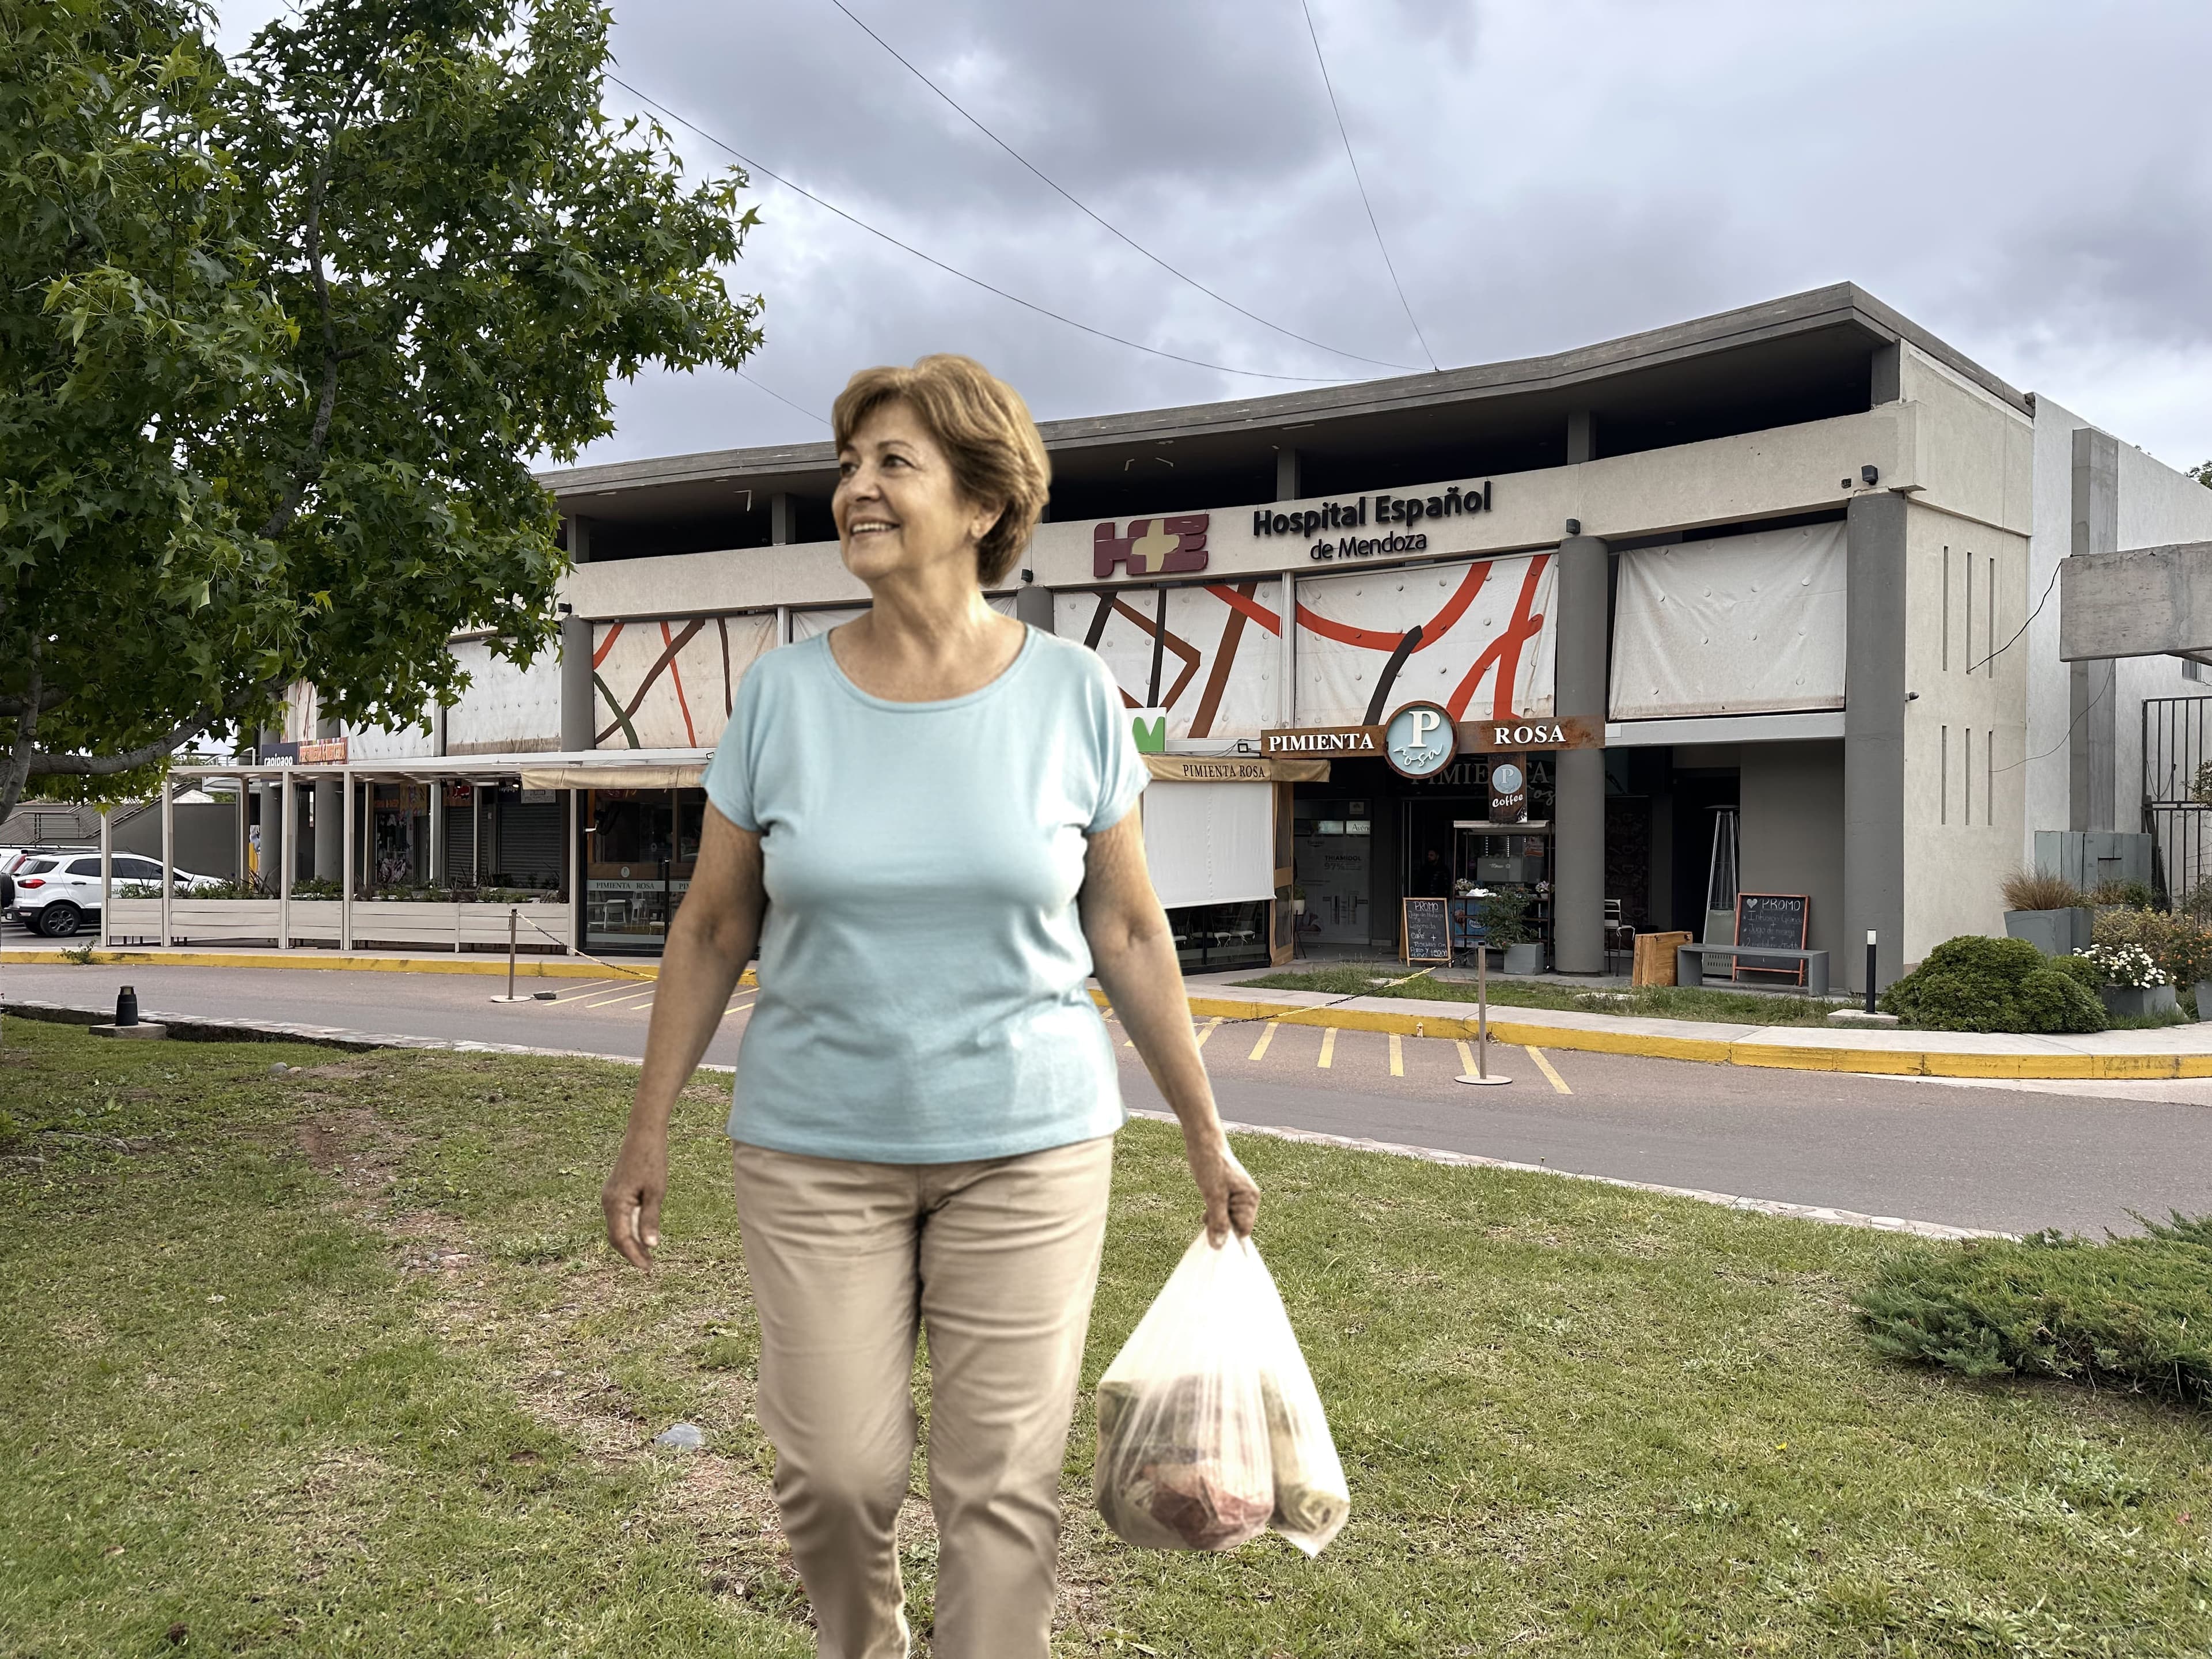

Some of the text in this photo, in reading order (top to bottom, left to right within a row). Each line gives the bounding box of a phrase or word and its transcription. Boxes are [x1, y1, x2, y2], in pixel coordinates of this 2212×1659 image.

[1253, 481, 1492, 537] Hospital Español
[1310, 531, 1427, 560] de Mendoza
[1268, 725, 1566, 752] PIMIENTA ROSA
[1408, 710, 1440, 748] P
[1183, 764, 1266, 778] PIMIENTA ROSA
[1501, 768, 1514, 784] P
[1492, 794, 1524, 808] Coffee
[1762, 899, 1801, 911] PROMO
